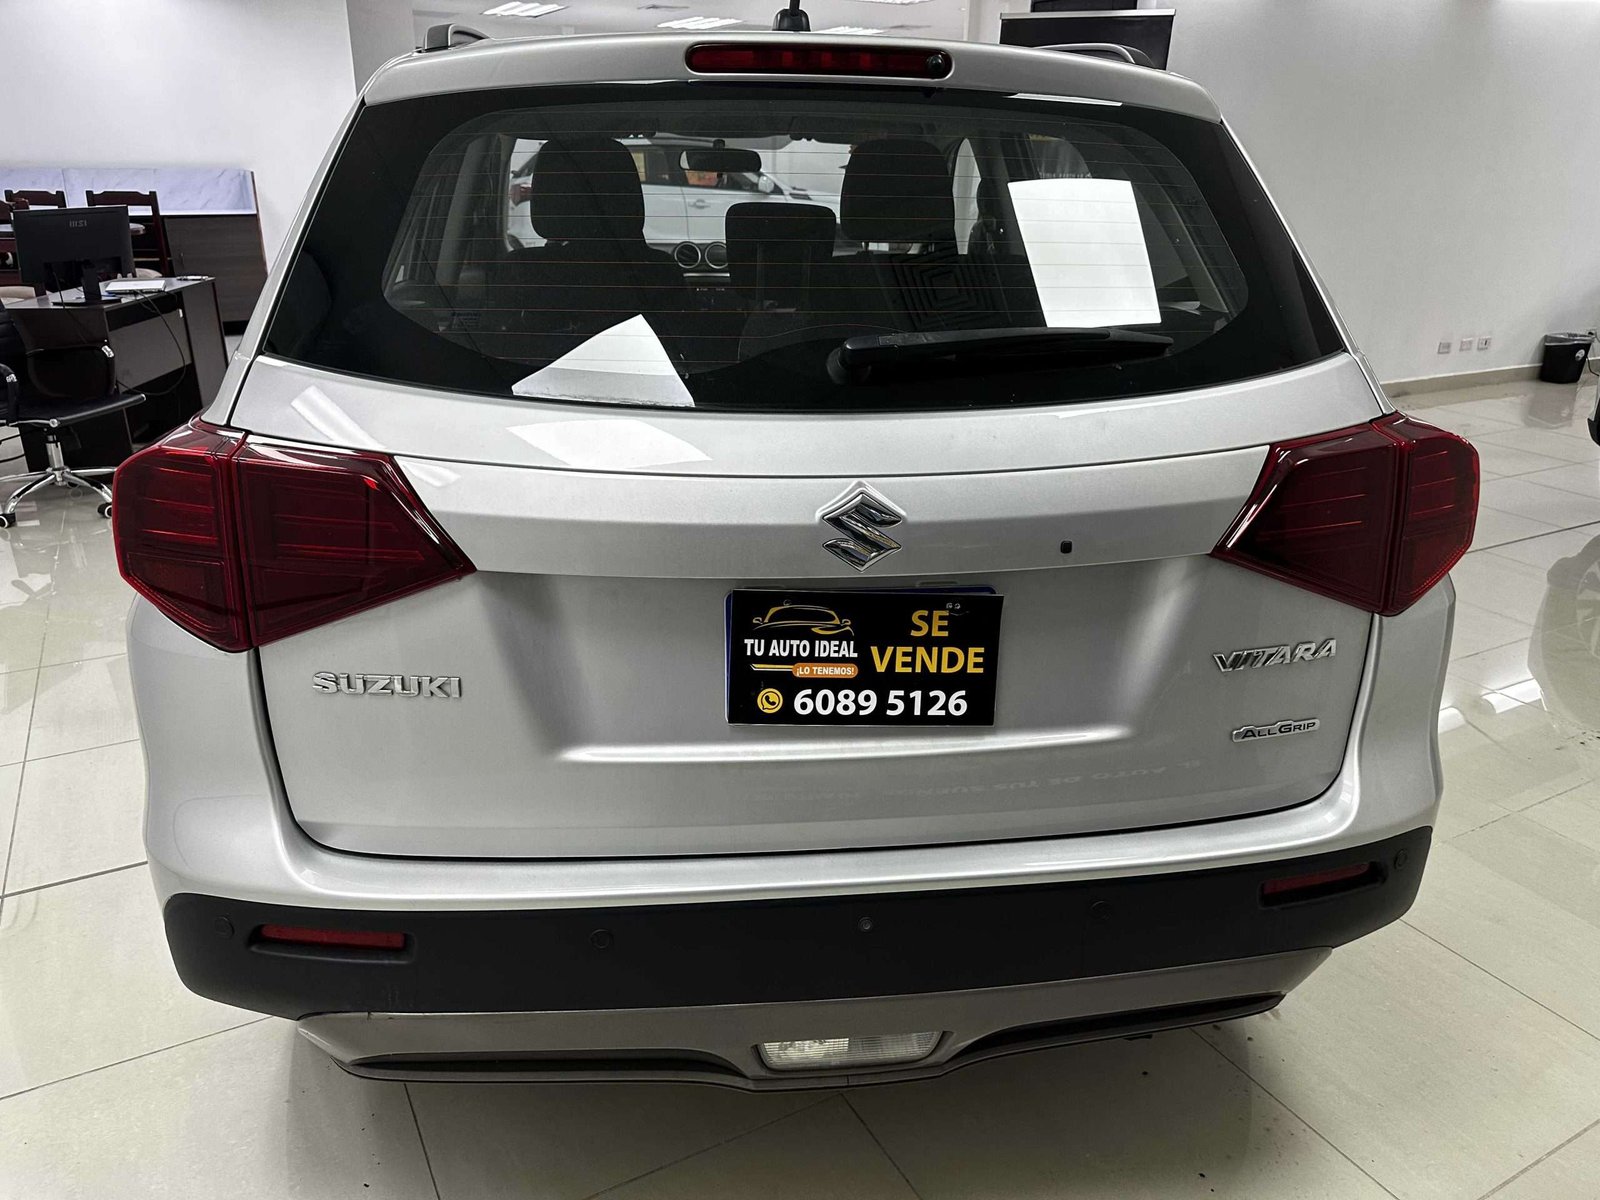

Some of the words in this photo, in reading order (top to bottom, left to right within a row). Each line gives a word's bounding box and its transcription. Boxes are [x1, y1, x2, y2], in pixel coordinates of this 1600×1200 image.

[910, 609, 950, 637] SE
[744, 638, 765, 656] TU
[768, 639, 810, 657] AUTO
[814, 640, 858, 658] IDEAL
[870, 646, 985, 674] VENDE
[1212, 638, 1338, 673] VITARA
[312, 671, 462, 699] SUZUKI
[796, 666, 810, 677] ¡LO
[812, 666, 855, 676] TENEMOS!
[793, 688, 878, 716] 6089
[886, 690, 968, 717] 5126
